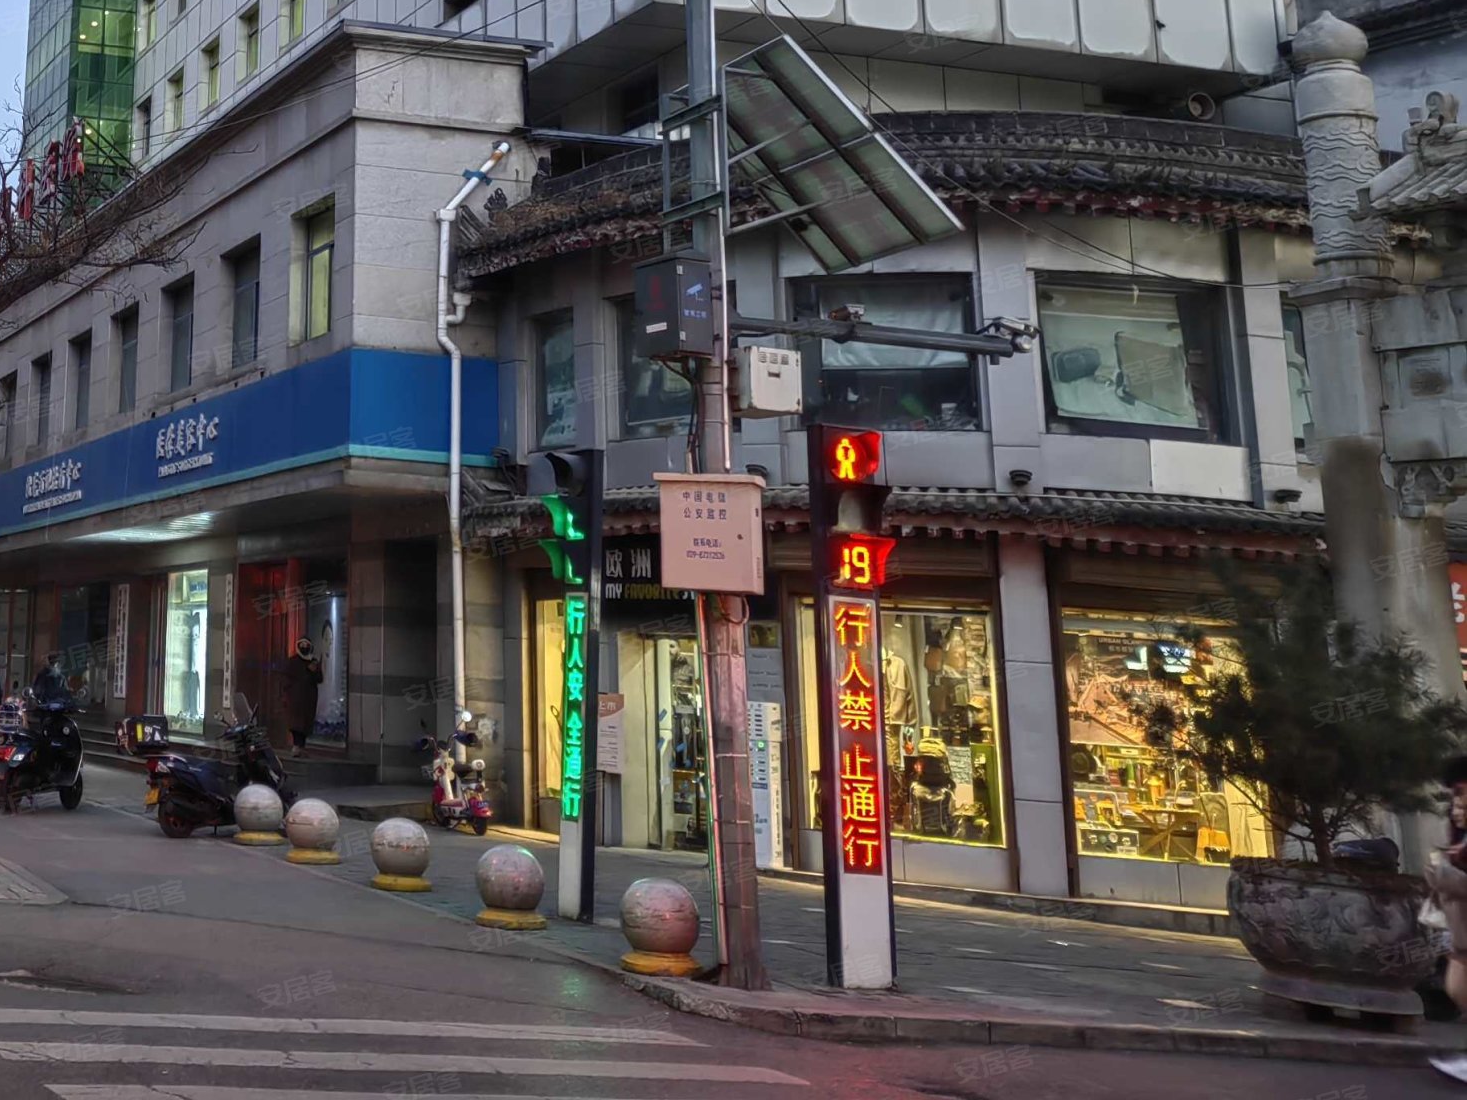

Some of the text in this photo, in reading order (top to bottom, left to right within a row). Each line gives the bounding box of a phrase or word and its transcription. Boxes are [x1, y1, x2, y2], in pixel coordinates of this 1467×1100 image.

[683, 507, 727, 520] 公安监控
[843, 546, 870, 584] 19
[605, 583, 622, 599] MY
[564, 600, 585, 817] 行人安全通行
[835, 606, 879, 867] 行人禁止通行
